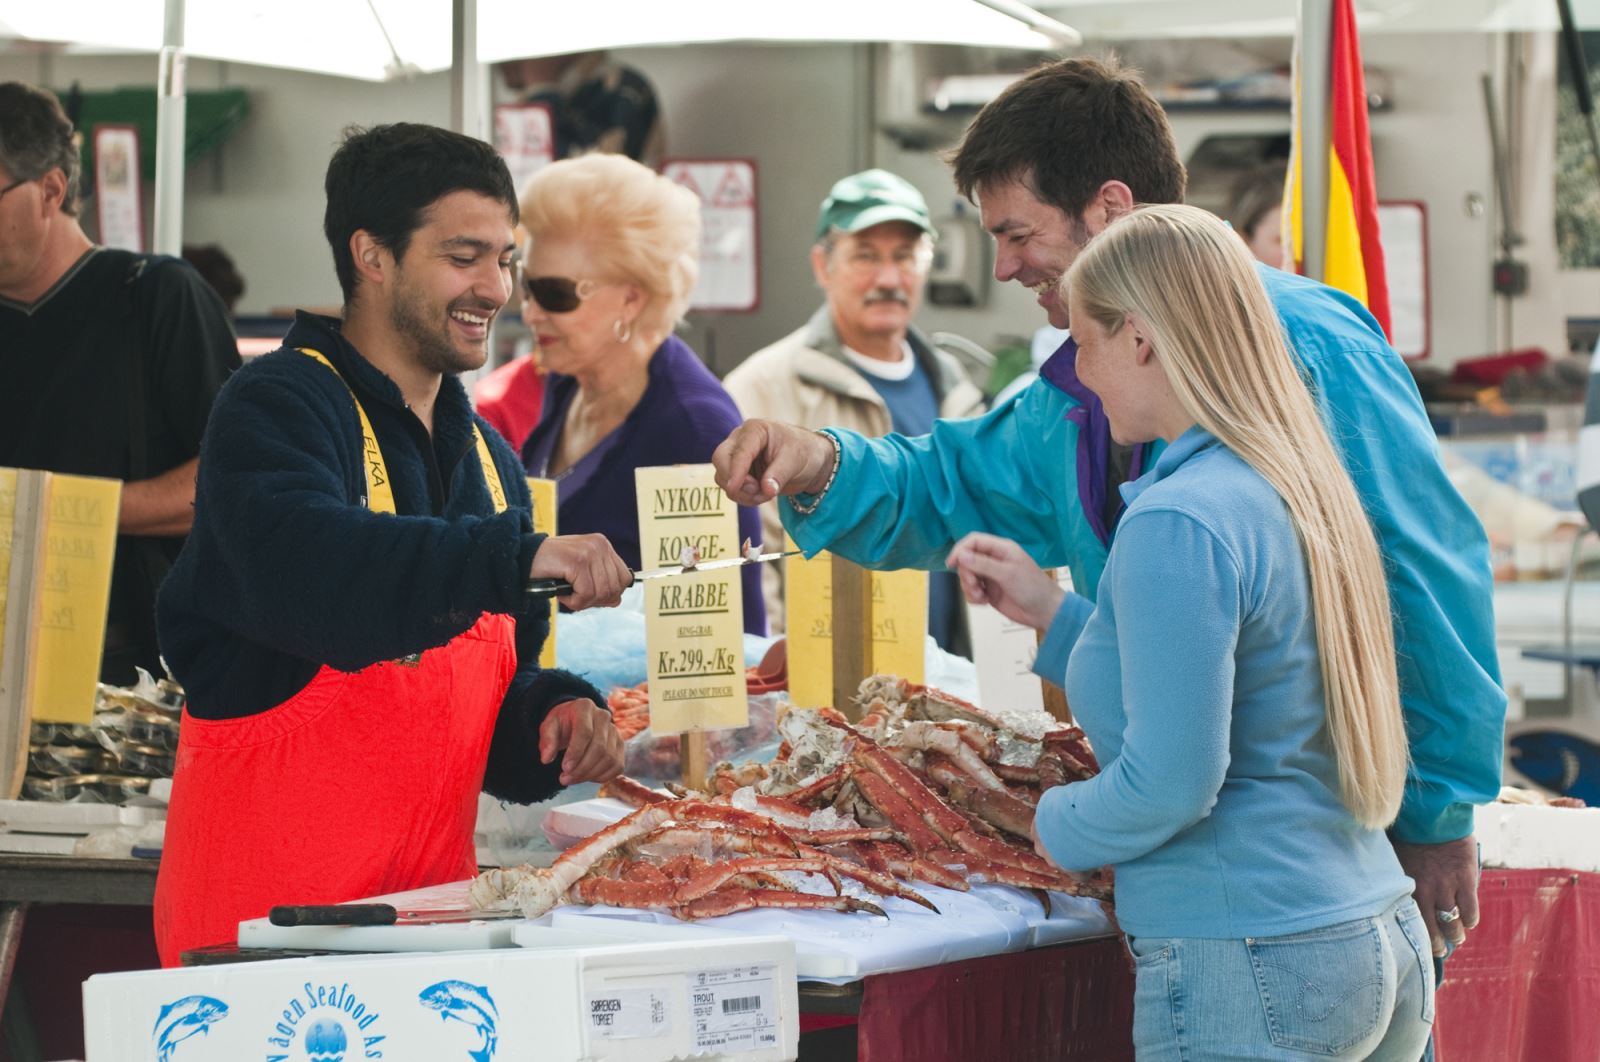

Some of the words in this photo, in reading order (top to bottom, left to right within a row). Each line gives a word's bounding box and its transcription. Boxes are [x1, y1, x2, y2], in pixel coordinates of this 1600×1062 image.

[363, 435, 385, 487] ELKA
[482, 462, 505, 507] ELKA
[654, 487, 723, 513] NYKOKT
[658, 583, 728, 610] KRABBE
[658, 647, 735, 674] Kr.299,-/Kg
[591, 999, 621, 1012] SØRENSEN
[693, 992, 714, 1003] TROUT
[304, 982, 379, 1031] Seafood
[363, 1035, 387, 1059] As
[592, 1013, 614, 1026] TORGET
